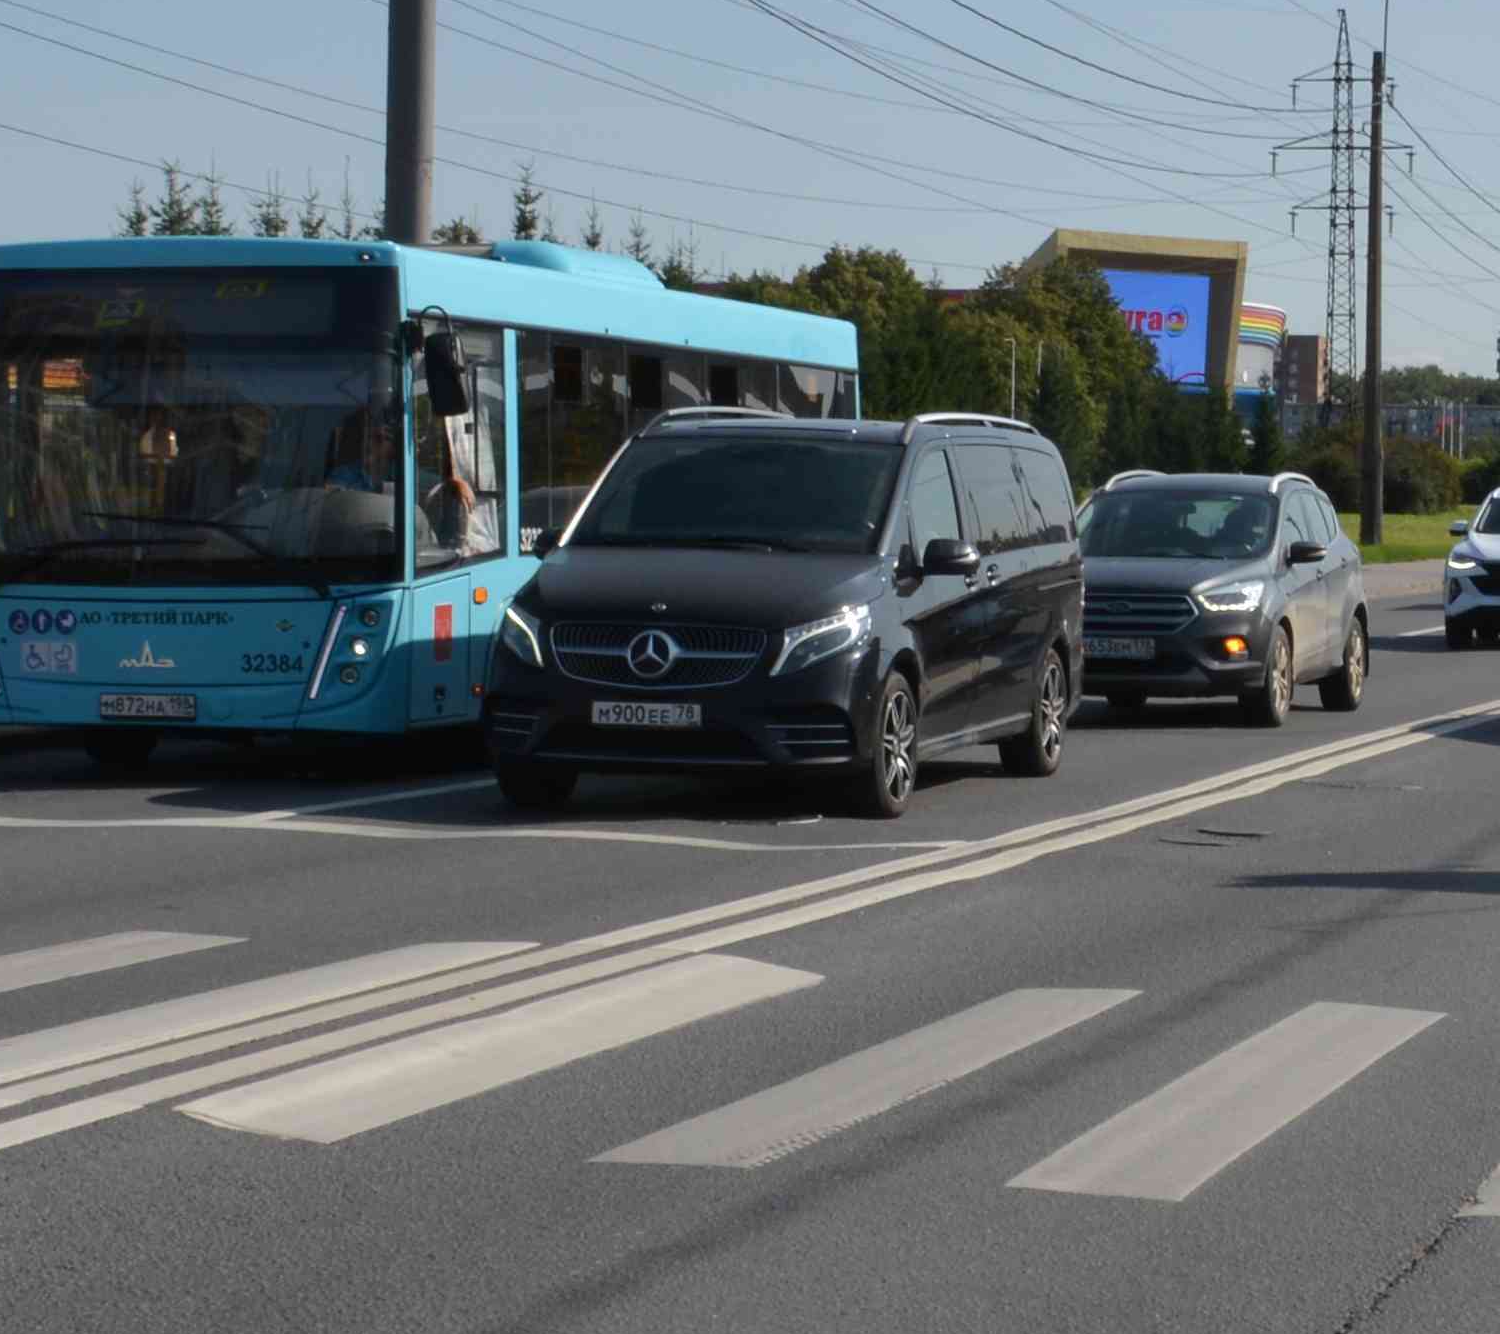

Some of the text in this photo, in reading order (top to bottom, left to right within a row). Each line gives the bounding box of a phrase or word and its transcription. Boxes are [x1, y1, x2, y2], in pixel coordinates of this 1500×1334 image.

[79, 610, 102, 625] АО
[241, 654, 304, 674] 32384
[598, 705, 695, 724] М900ЕЕ 78
